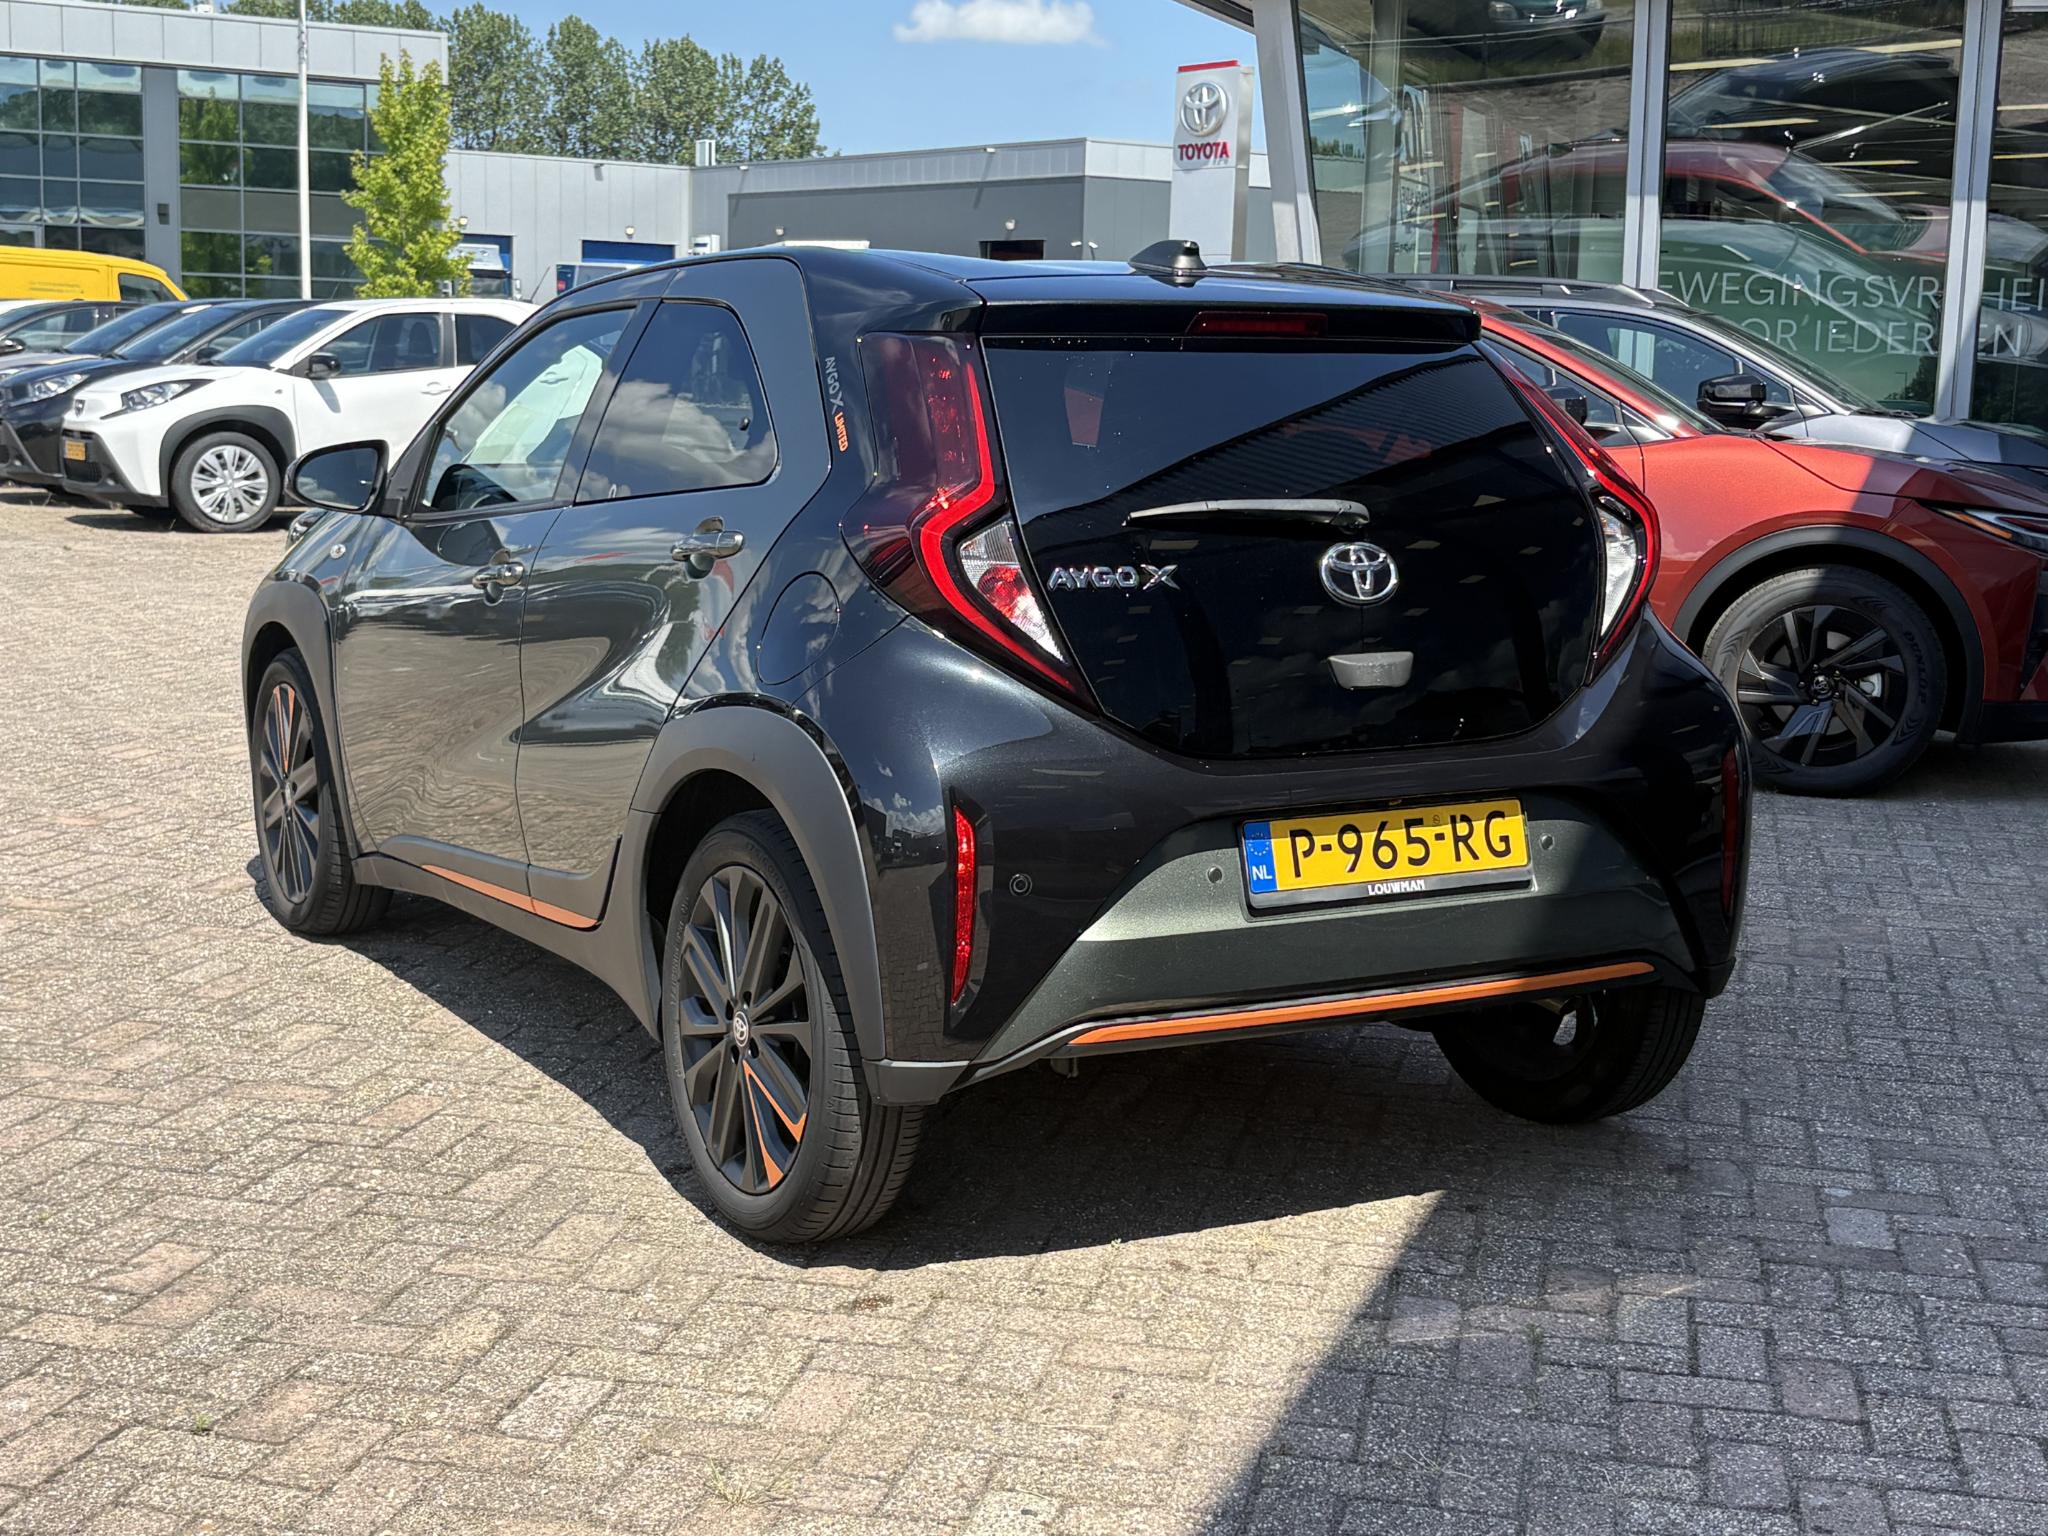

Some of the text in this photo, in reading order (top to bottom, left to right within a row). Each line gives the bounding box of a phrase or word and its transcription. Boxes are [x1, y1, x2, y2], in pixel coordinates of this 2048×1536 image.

[1178, 142, 1230, 160] TOYOTA
[825, 357, 840, 394] AYGO
[835, 411, 849, 452] LIMITED
[1048, 564, 1180, 590] AYGO X
[1252, 810, 1512, 881] NL P-965-RG
[1367, 879, 1425, 896] LOUWMAN
